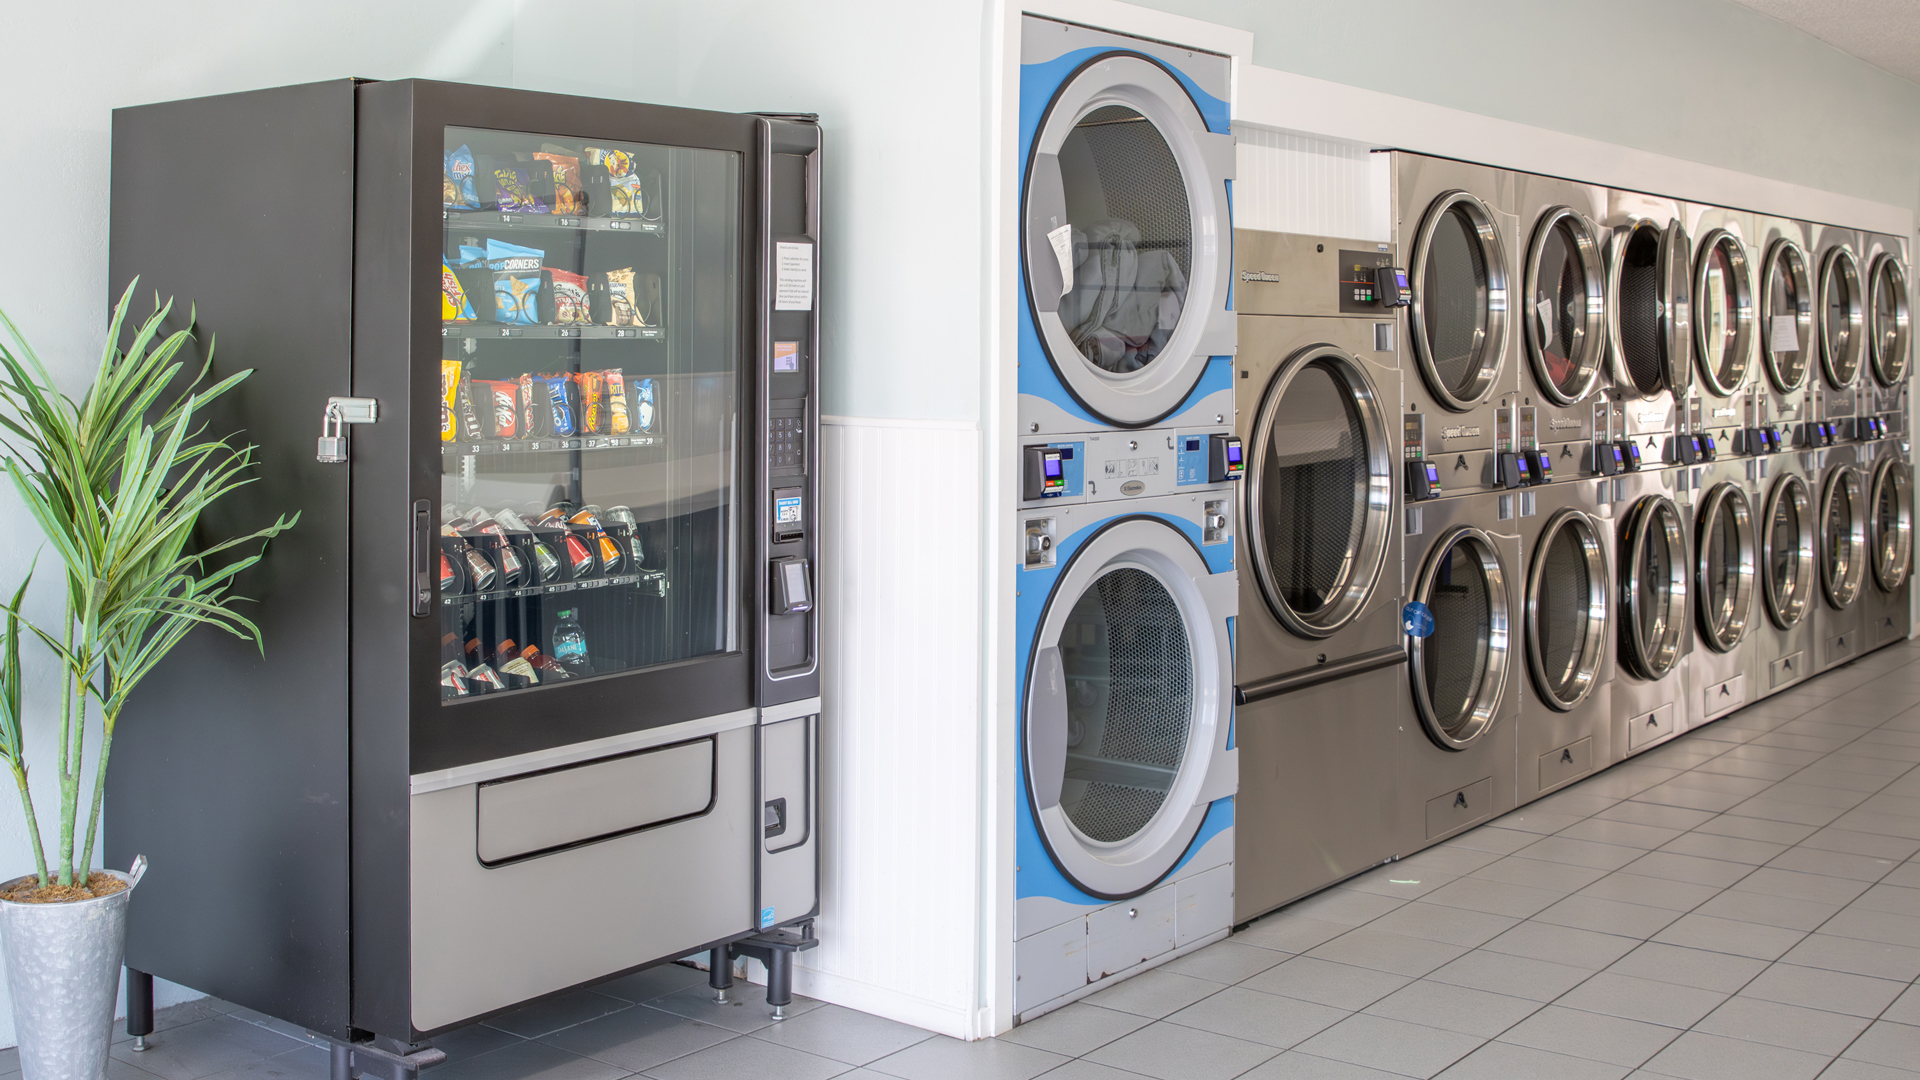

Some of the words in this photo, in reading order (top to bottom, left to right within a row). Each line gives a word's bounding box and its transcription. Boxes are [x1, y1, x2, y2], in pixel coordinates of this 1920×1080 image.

[611, 384, 624, 395] RITZ
[646, 437, 653, 445] 39
[472, 445, 480, 453] 33
[502, 443, 510, 451] 34
[532, 442, 540, 450] 35
[557, 644, 577, 653] DASANI
